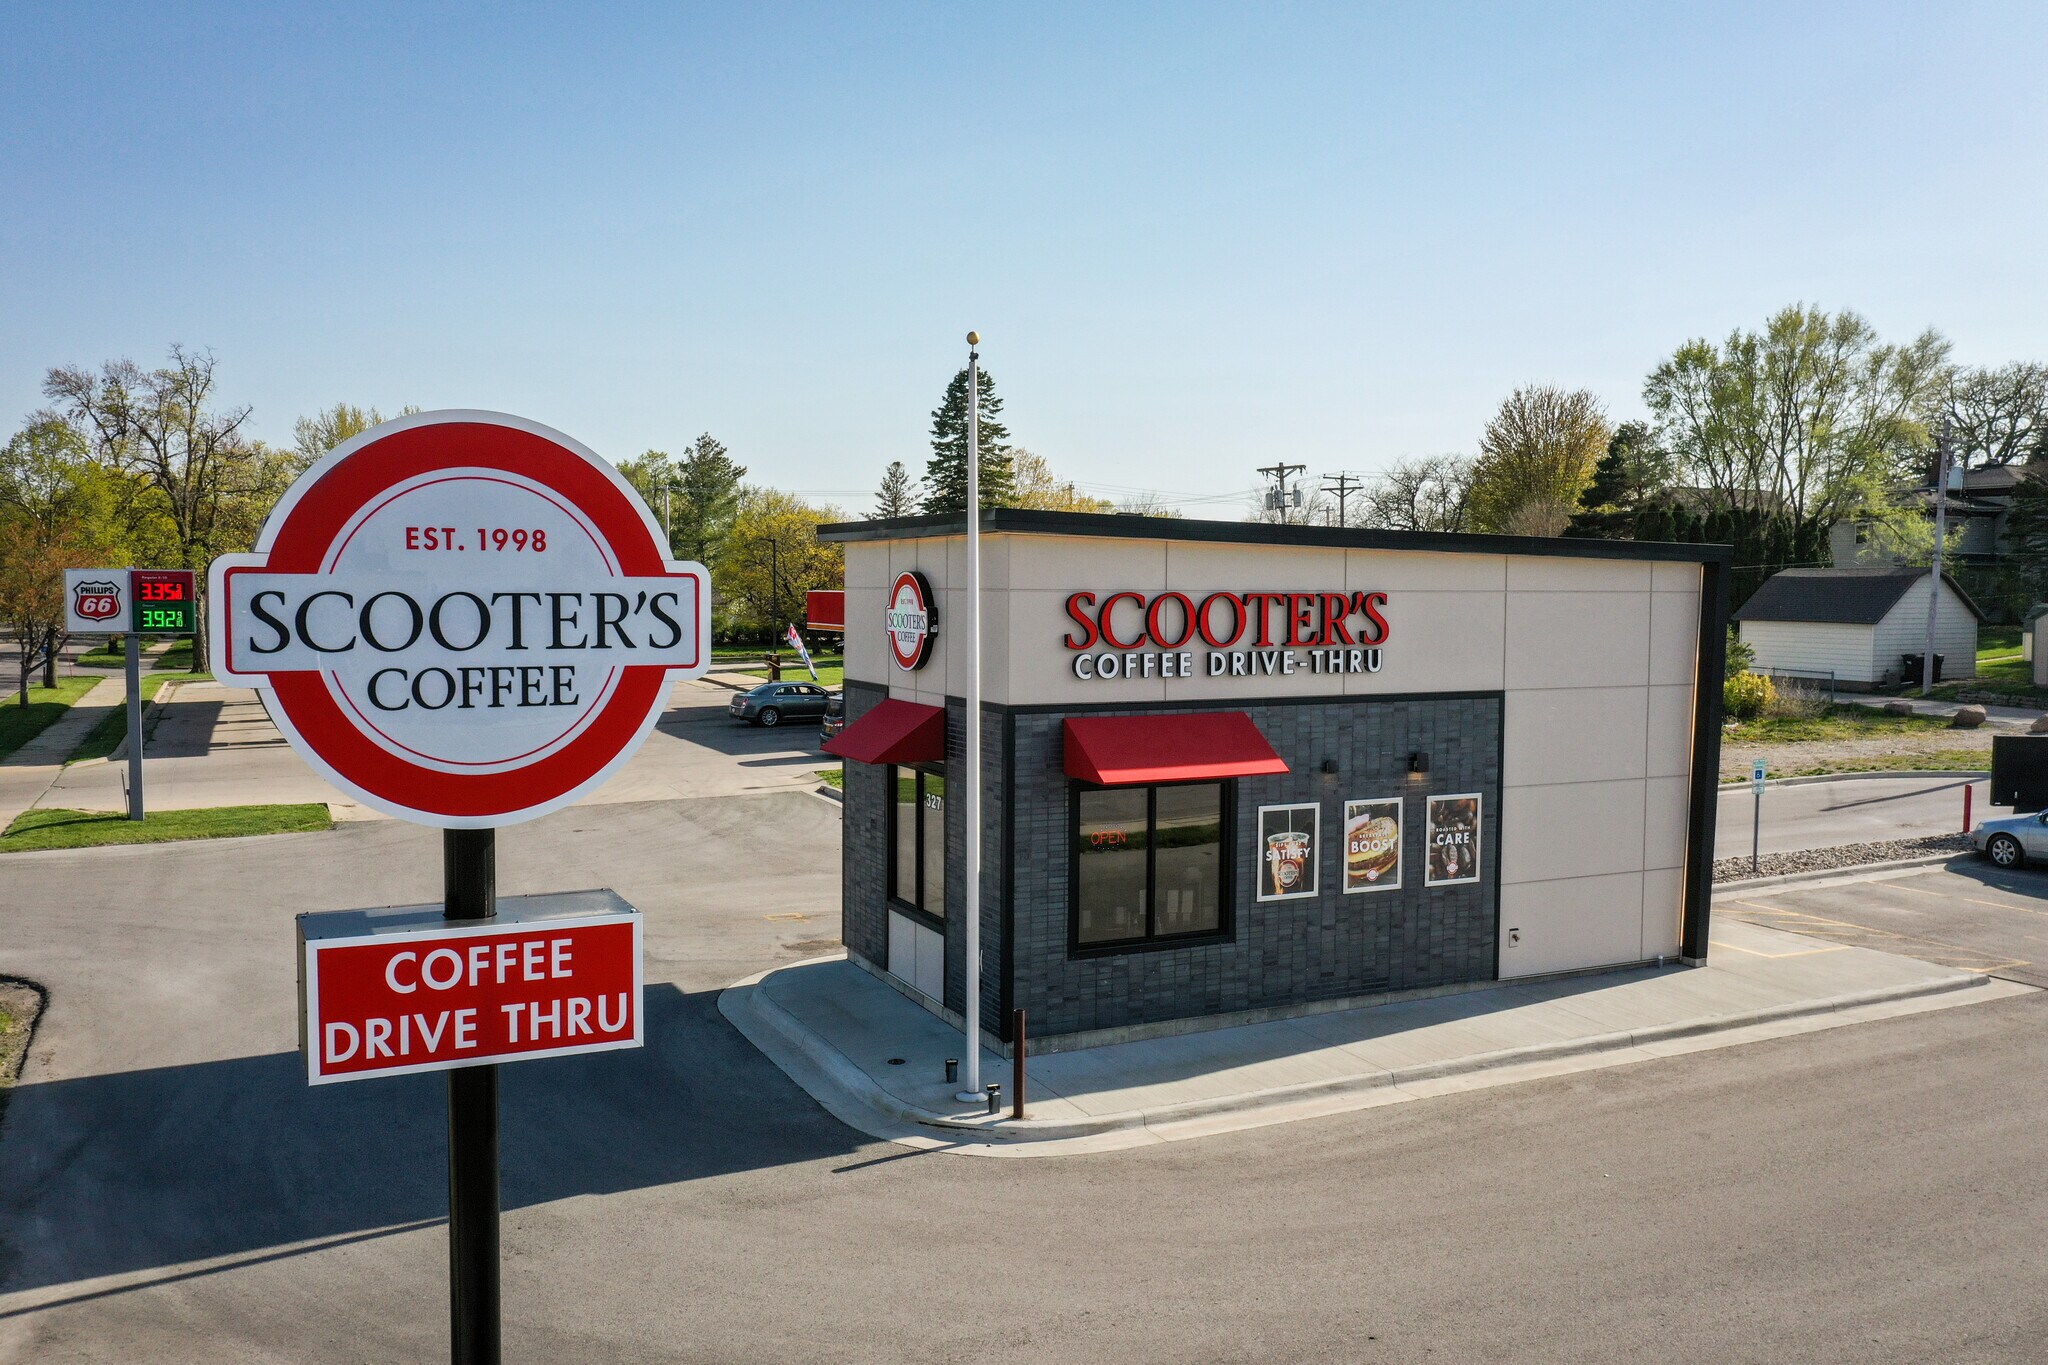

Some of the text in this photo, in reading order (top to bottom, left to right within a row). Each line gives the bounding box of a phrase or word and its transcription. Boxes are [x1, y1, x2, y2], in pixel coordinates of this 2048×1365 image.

[405, 526, 548, 553] EST. 1998
[80, 586, 114, 595] PHILLIPS
[83, 597, 112, 613] 66
[249, 590, 683, 655] SCOOTER'S
[888, 612, 926, 630] SCOOTER'S
[1063, 591, 1390, 650] SCOOTER'S
[897, 631, 916, 643] COFFEE
[1071, 648, 1383, 681] COFFEE DRIVE-THRU
[367, 665, 580, 712] COFFEE
[926, 793, 942, 811] 327
[1090, 829, 1127, 845] OPEN
[1351, 838, 1396, 854] BOOST
[1436, 831, 1470, 846] CARE
[1265, 847, 1311, 862] SATISFY
[384, 938, 574, 994] COFFEE
[325, 992, 628, 1064] DRIVE THRU
